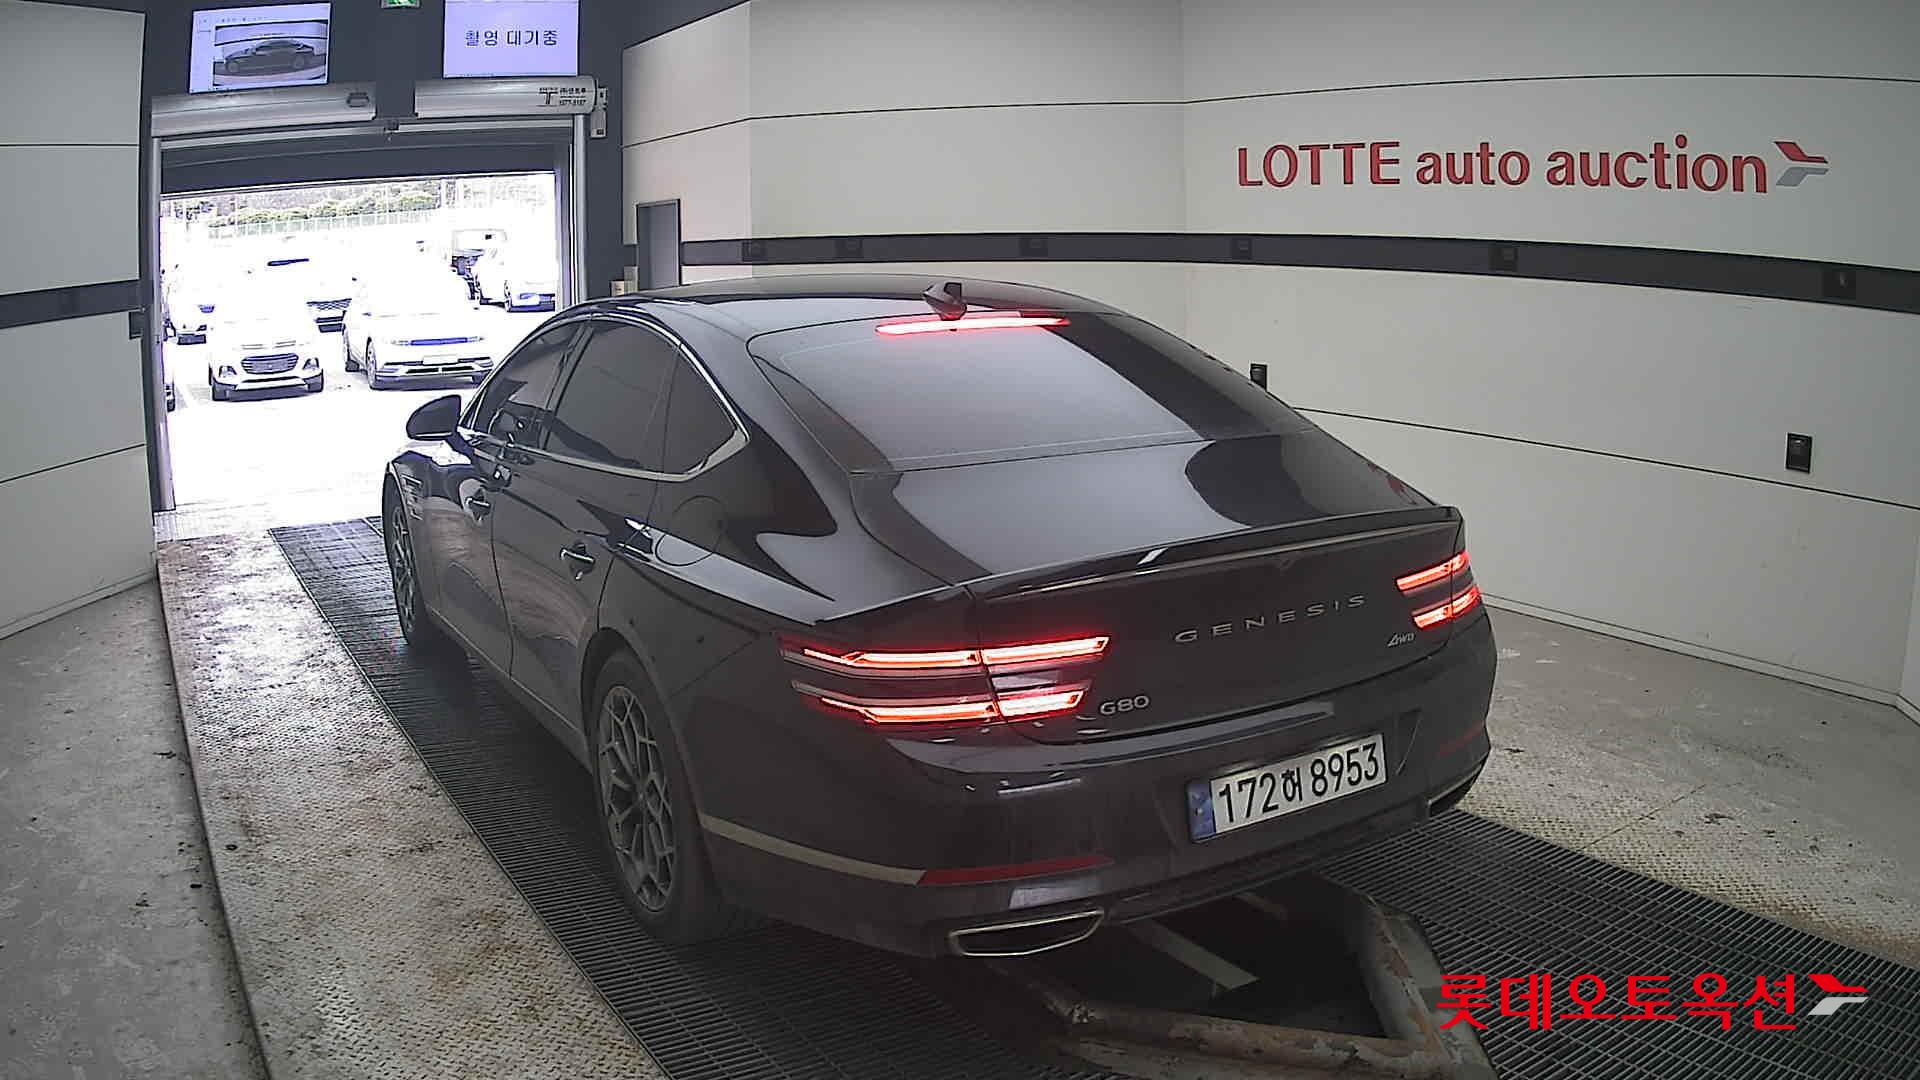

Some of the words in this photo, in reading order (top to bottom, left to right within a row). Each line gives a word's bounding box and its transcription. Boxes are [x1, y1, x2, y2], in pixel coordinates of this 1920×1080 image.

[506, 29, 558, 46] 대기중
[1237, 141, 1400, 188] LOTTE
[1416, 142, 1531, 186] auto
[1546, 134, 1768, 194] auction
[1174, 594, 1366, 643] GENESIS
[1099, 695, 1150, 715] G80
[1218, 766, 1303, 823] 172허
[1310, 742, 1379, 797] 8953
